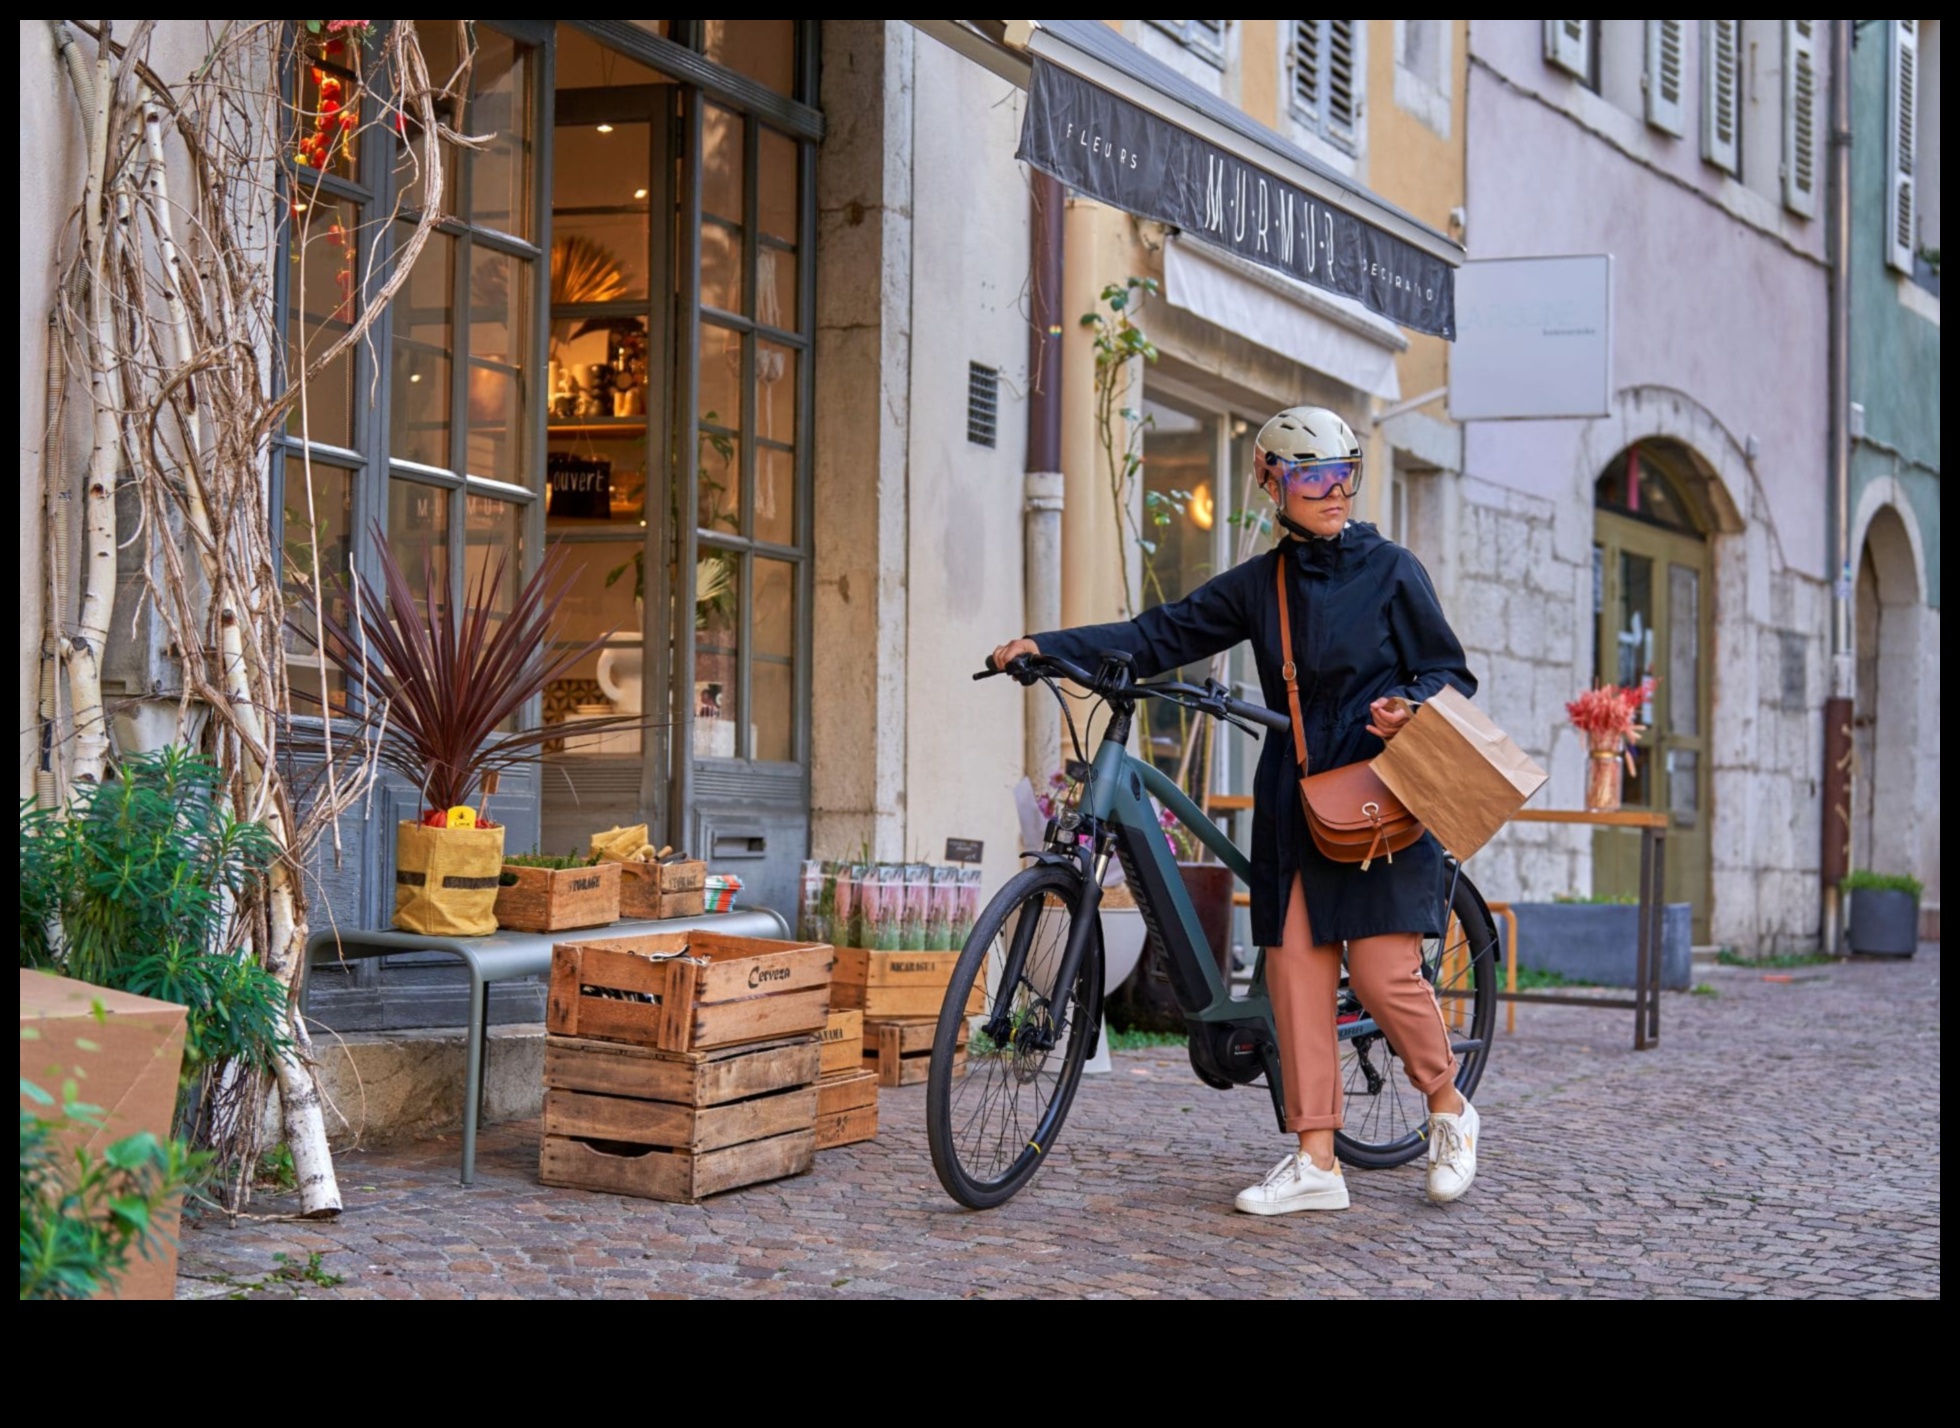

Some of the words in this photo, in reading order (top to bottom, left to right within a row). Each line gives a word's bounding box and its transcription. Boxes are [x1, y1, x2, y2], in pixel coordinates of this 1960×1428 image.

[1066, 122, 1138, 170] FLEURS
[554, 470, 604, 492] ouvert
[748, 966, 790, 989] Cerveza
